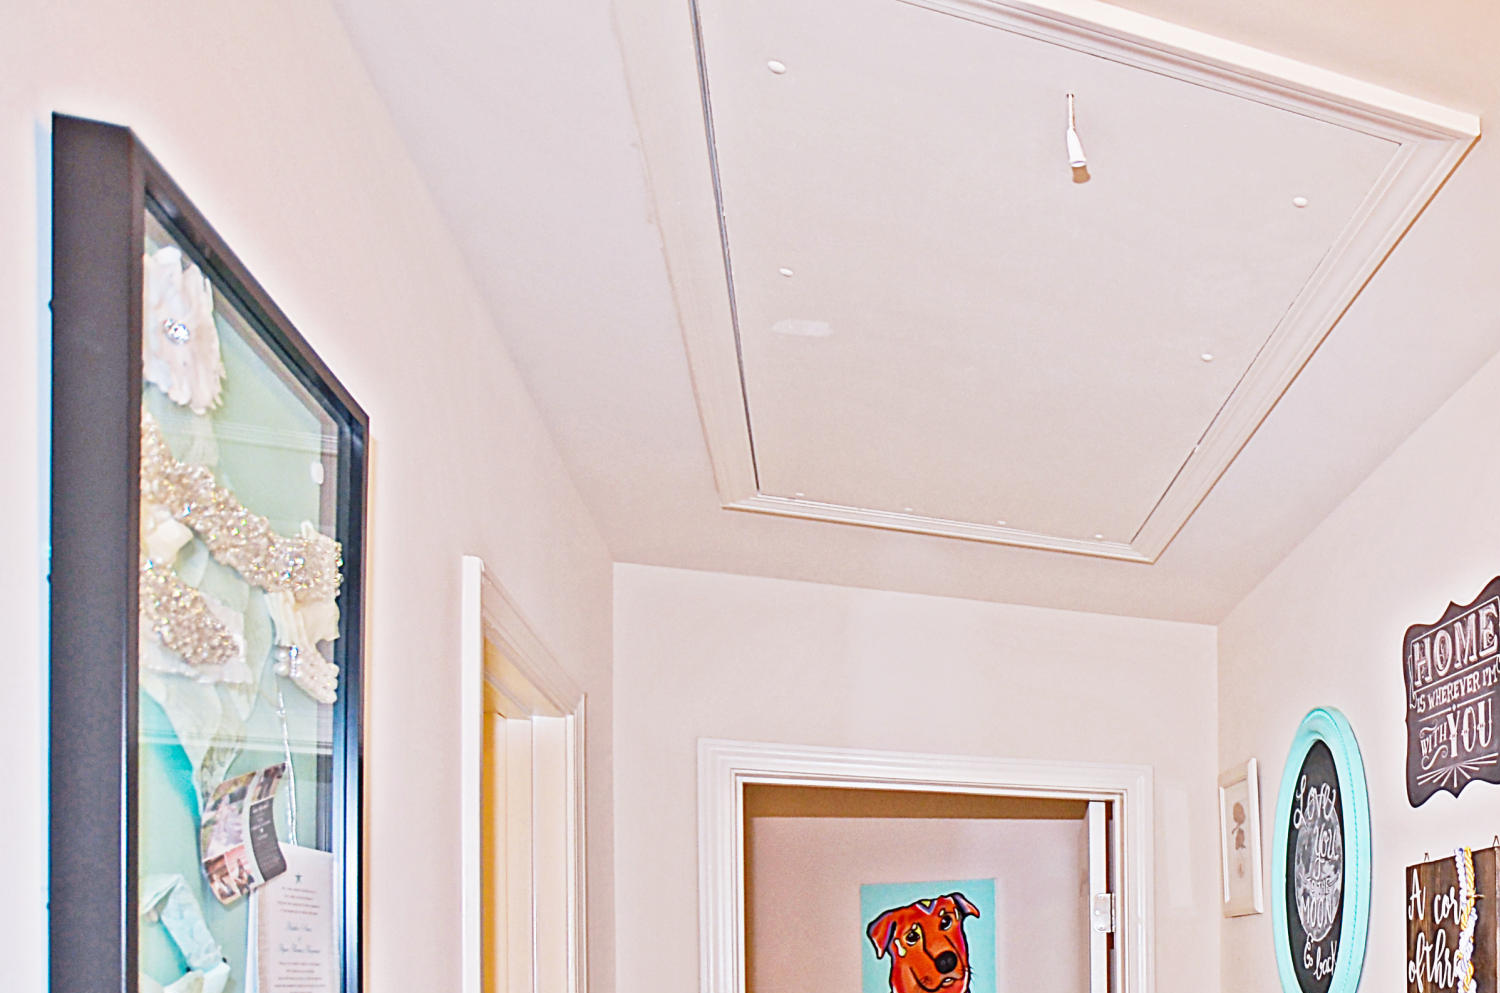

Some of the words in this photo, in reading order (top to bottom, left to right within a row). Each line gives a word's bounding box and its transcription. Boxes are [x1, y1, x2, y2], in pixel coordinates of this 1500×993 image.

[1412, 602, 1499, 688] HOME
[1415, 692, 1426, 714] IS
[1428, 670, 1481, 709] WHEREVER
[1482, 664, 1499, 689] I'M
[1419, 721, 1448, 757] WITH
[1447, 697, 1494, 759] YOU
[1293, 774, 1337, 830] Love
[1300, 894, 1334, 929] MOON
[1408, 868, 1427, 921] A
[1433, 886, 1464, 926] cor
[1313, 940, 1337, 981] back
[1408, 931, 1426, 993] of
[1423, 928, 1462, 990] thr
